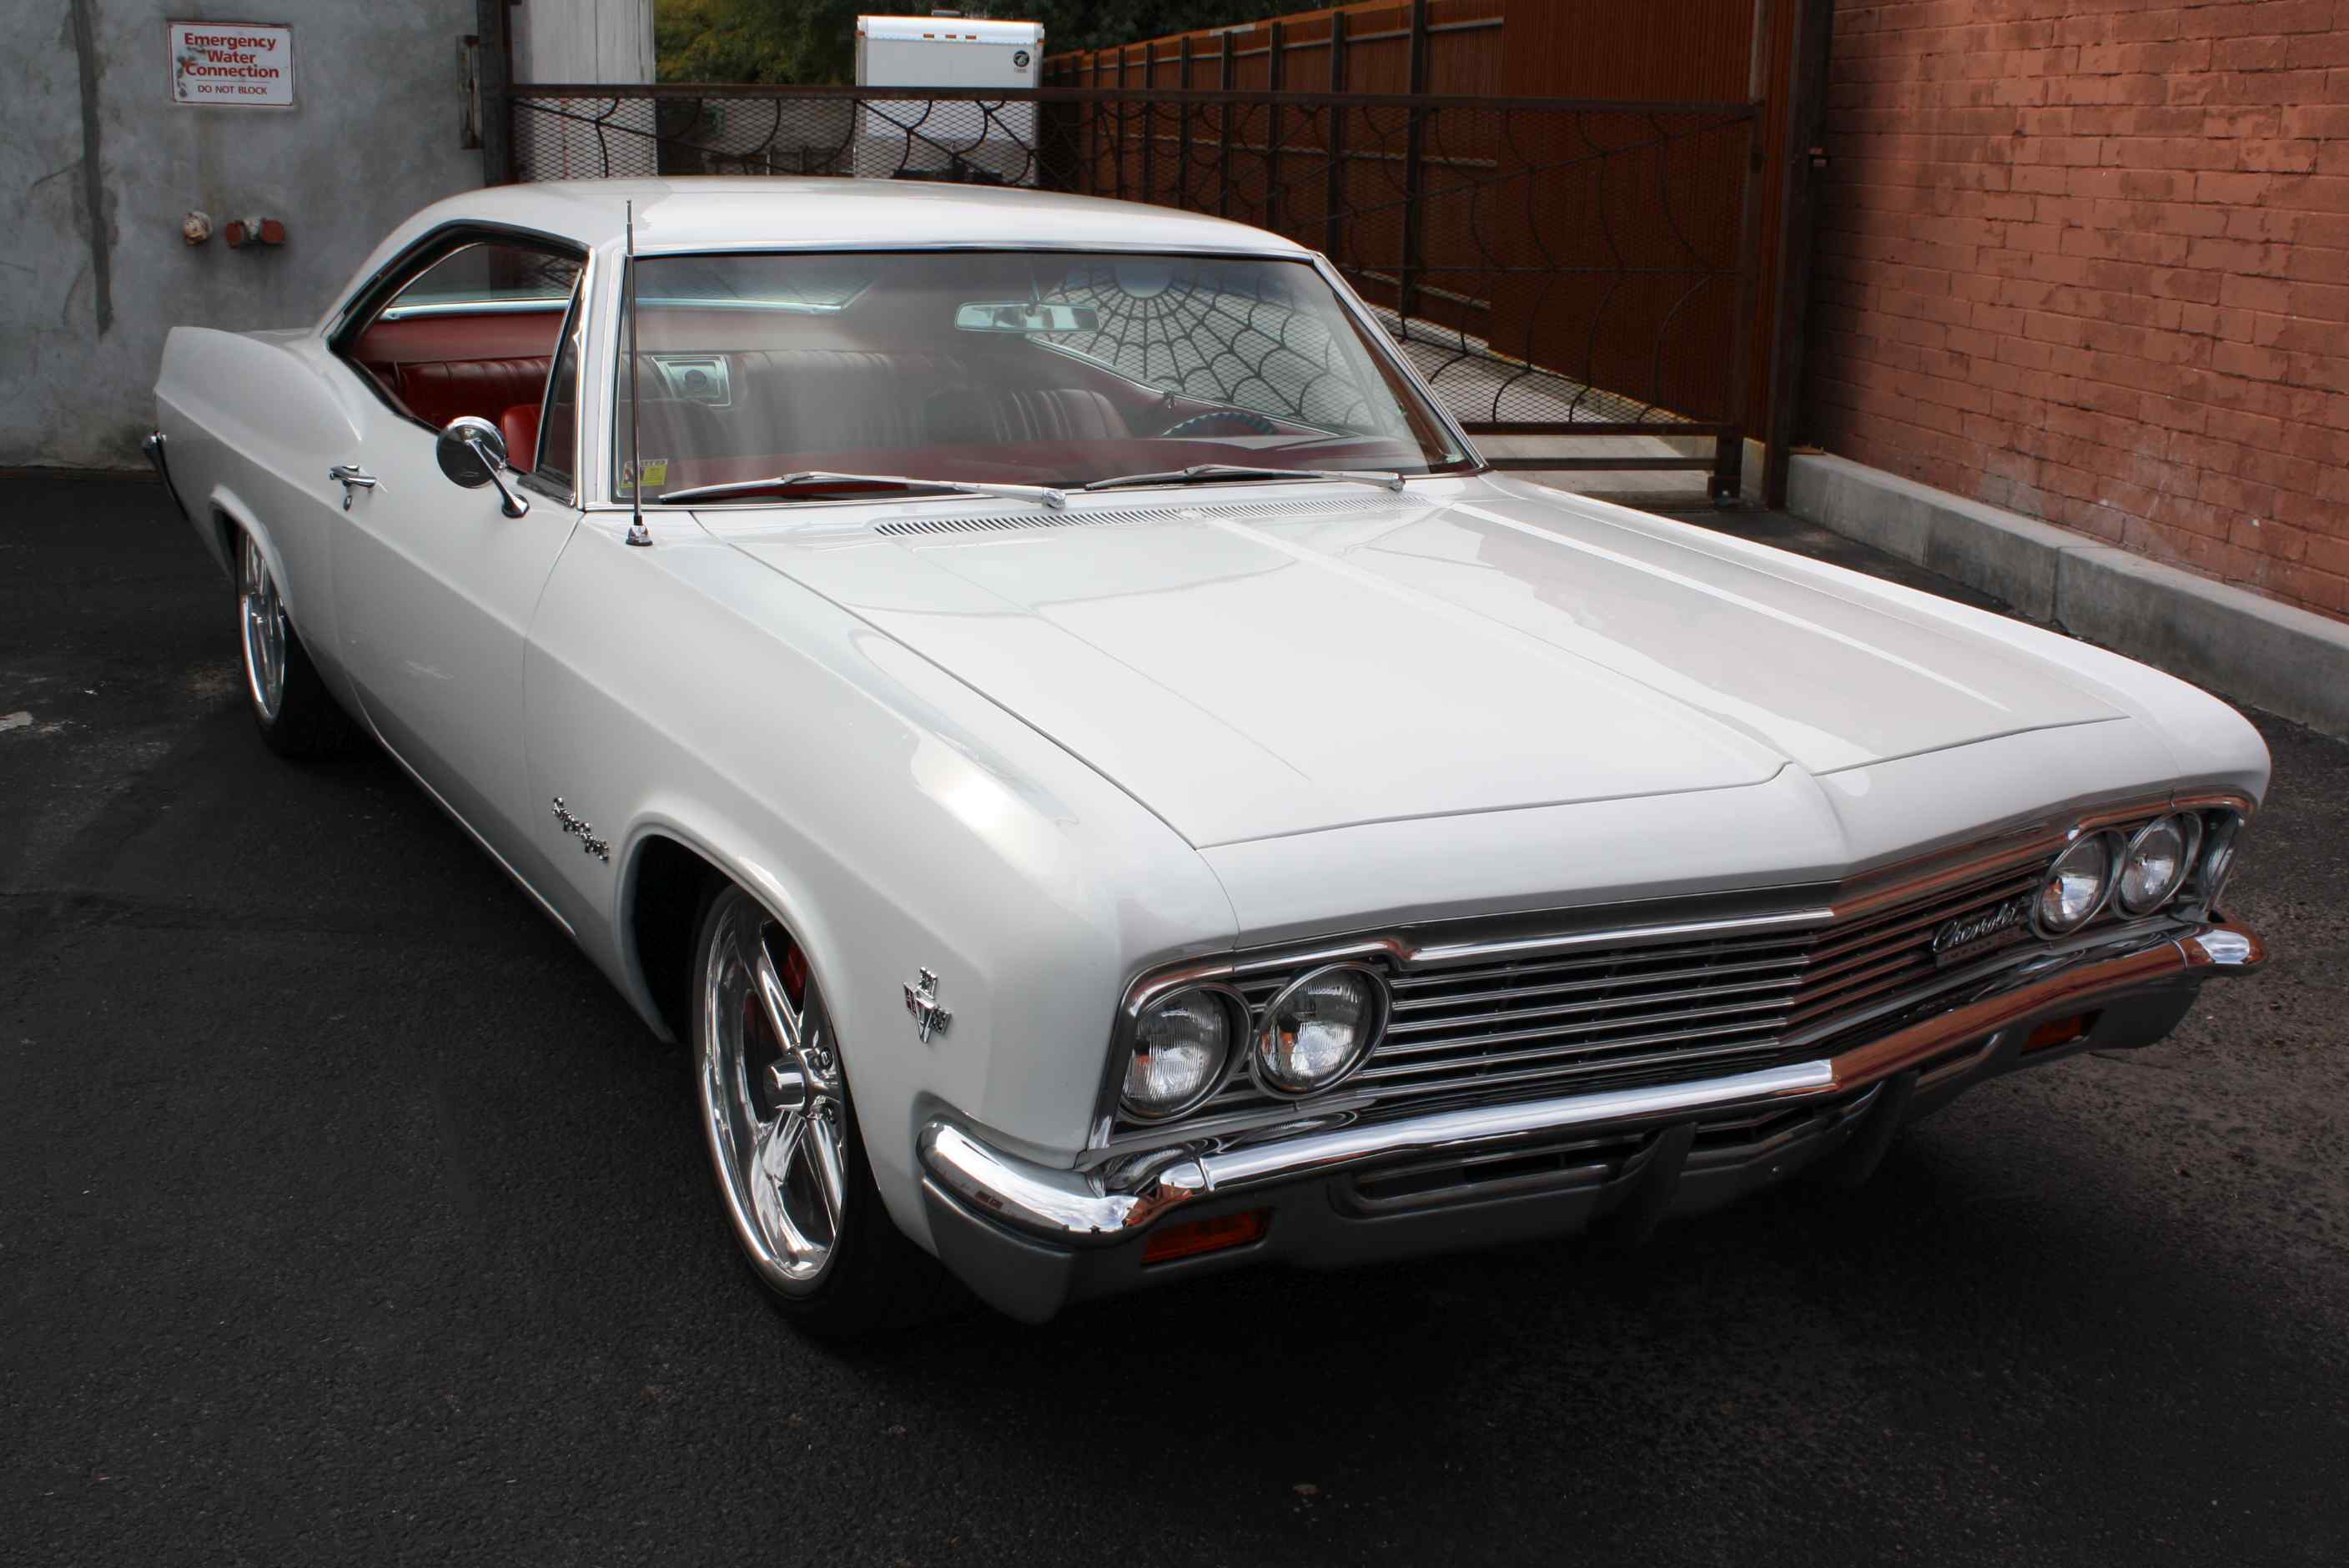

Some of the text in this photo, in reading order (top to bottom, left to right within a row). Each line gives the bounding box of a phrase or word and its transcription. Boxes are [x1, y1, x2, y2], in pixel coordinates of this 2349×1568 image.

[184, 33, 277, 51] Emergency
[208, 50, 256, 63] Water
[185, 63, 279, 78] Connection
[198, 85, 268, 95] DO NOT BLOCK
[1933, 902, 2019, 952] Chevrolet
